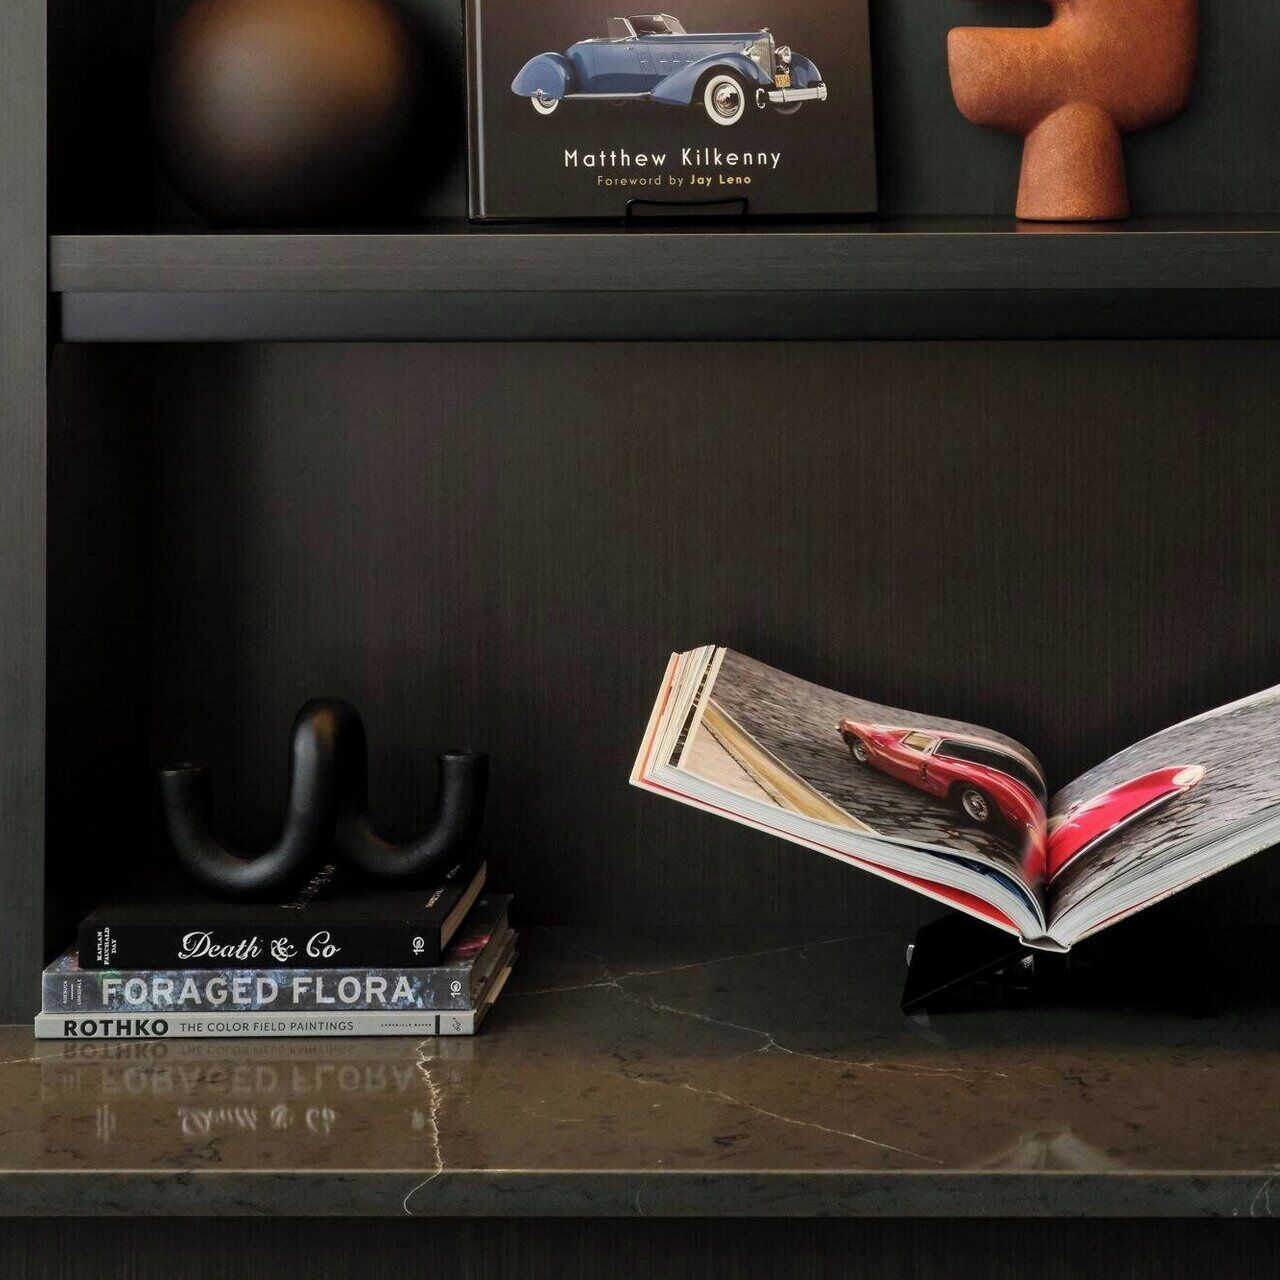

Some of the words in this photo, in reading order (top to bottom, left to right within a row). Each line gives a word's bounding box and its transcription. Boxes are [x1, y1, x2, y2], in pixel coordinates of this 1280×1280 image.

[564, 148, 667, 167] Matthew
[681, 147, 782, 169] Kilkenny
[597, 175, 662, 186] Foreword
[669, 175, 684, 187] by
[690, 174, 713, 187] Jay
[719, 174, 752, 185] Leno
[177, 930, 264, 960] Death
[270, 937, 298, 962] &
[306, 930, 341, 959] Co
[102, 976, 279, 1005] FORAGED
[292, 976, 415, 1004] FLORA
[63, 1019, 169, 1037] ROTHKO
[180, 1022, 203, 1032] THE
[207, 1022, 250, 1032] COLOR
[253, 1022, 287, 1032] FIELD
[290, 1021, 354, 1031] PAINTINGS
